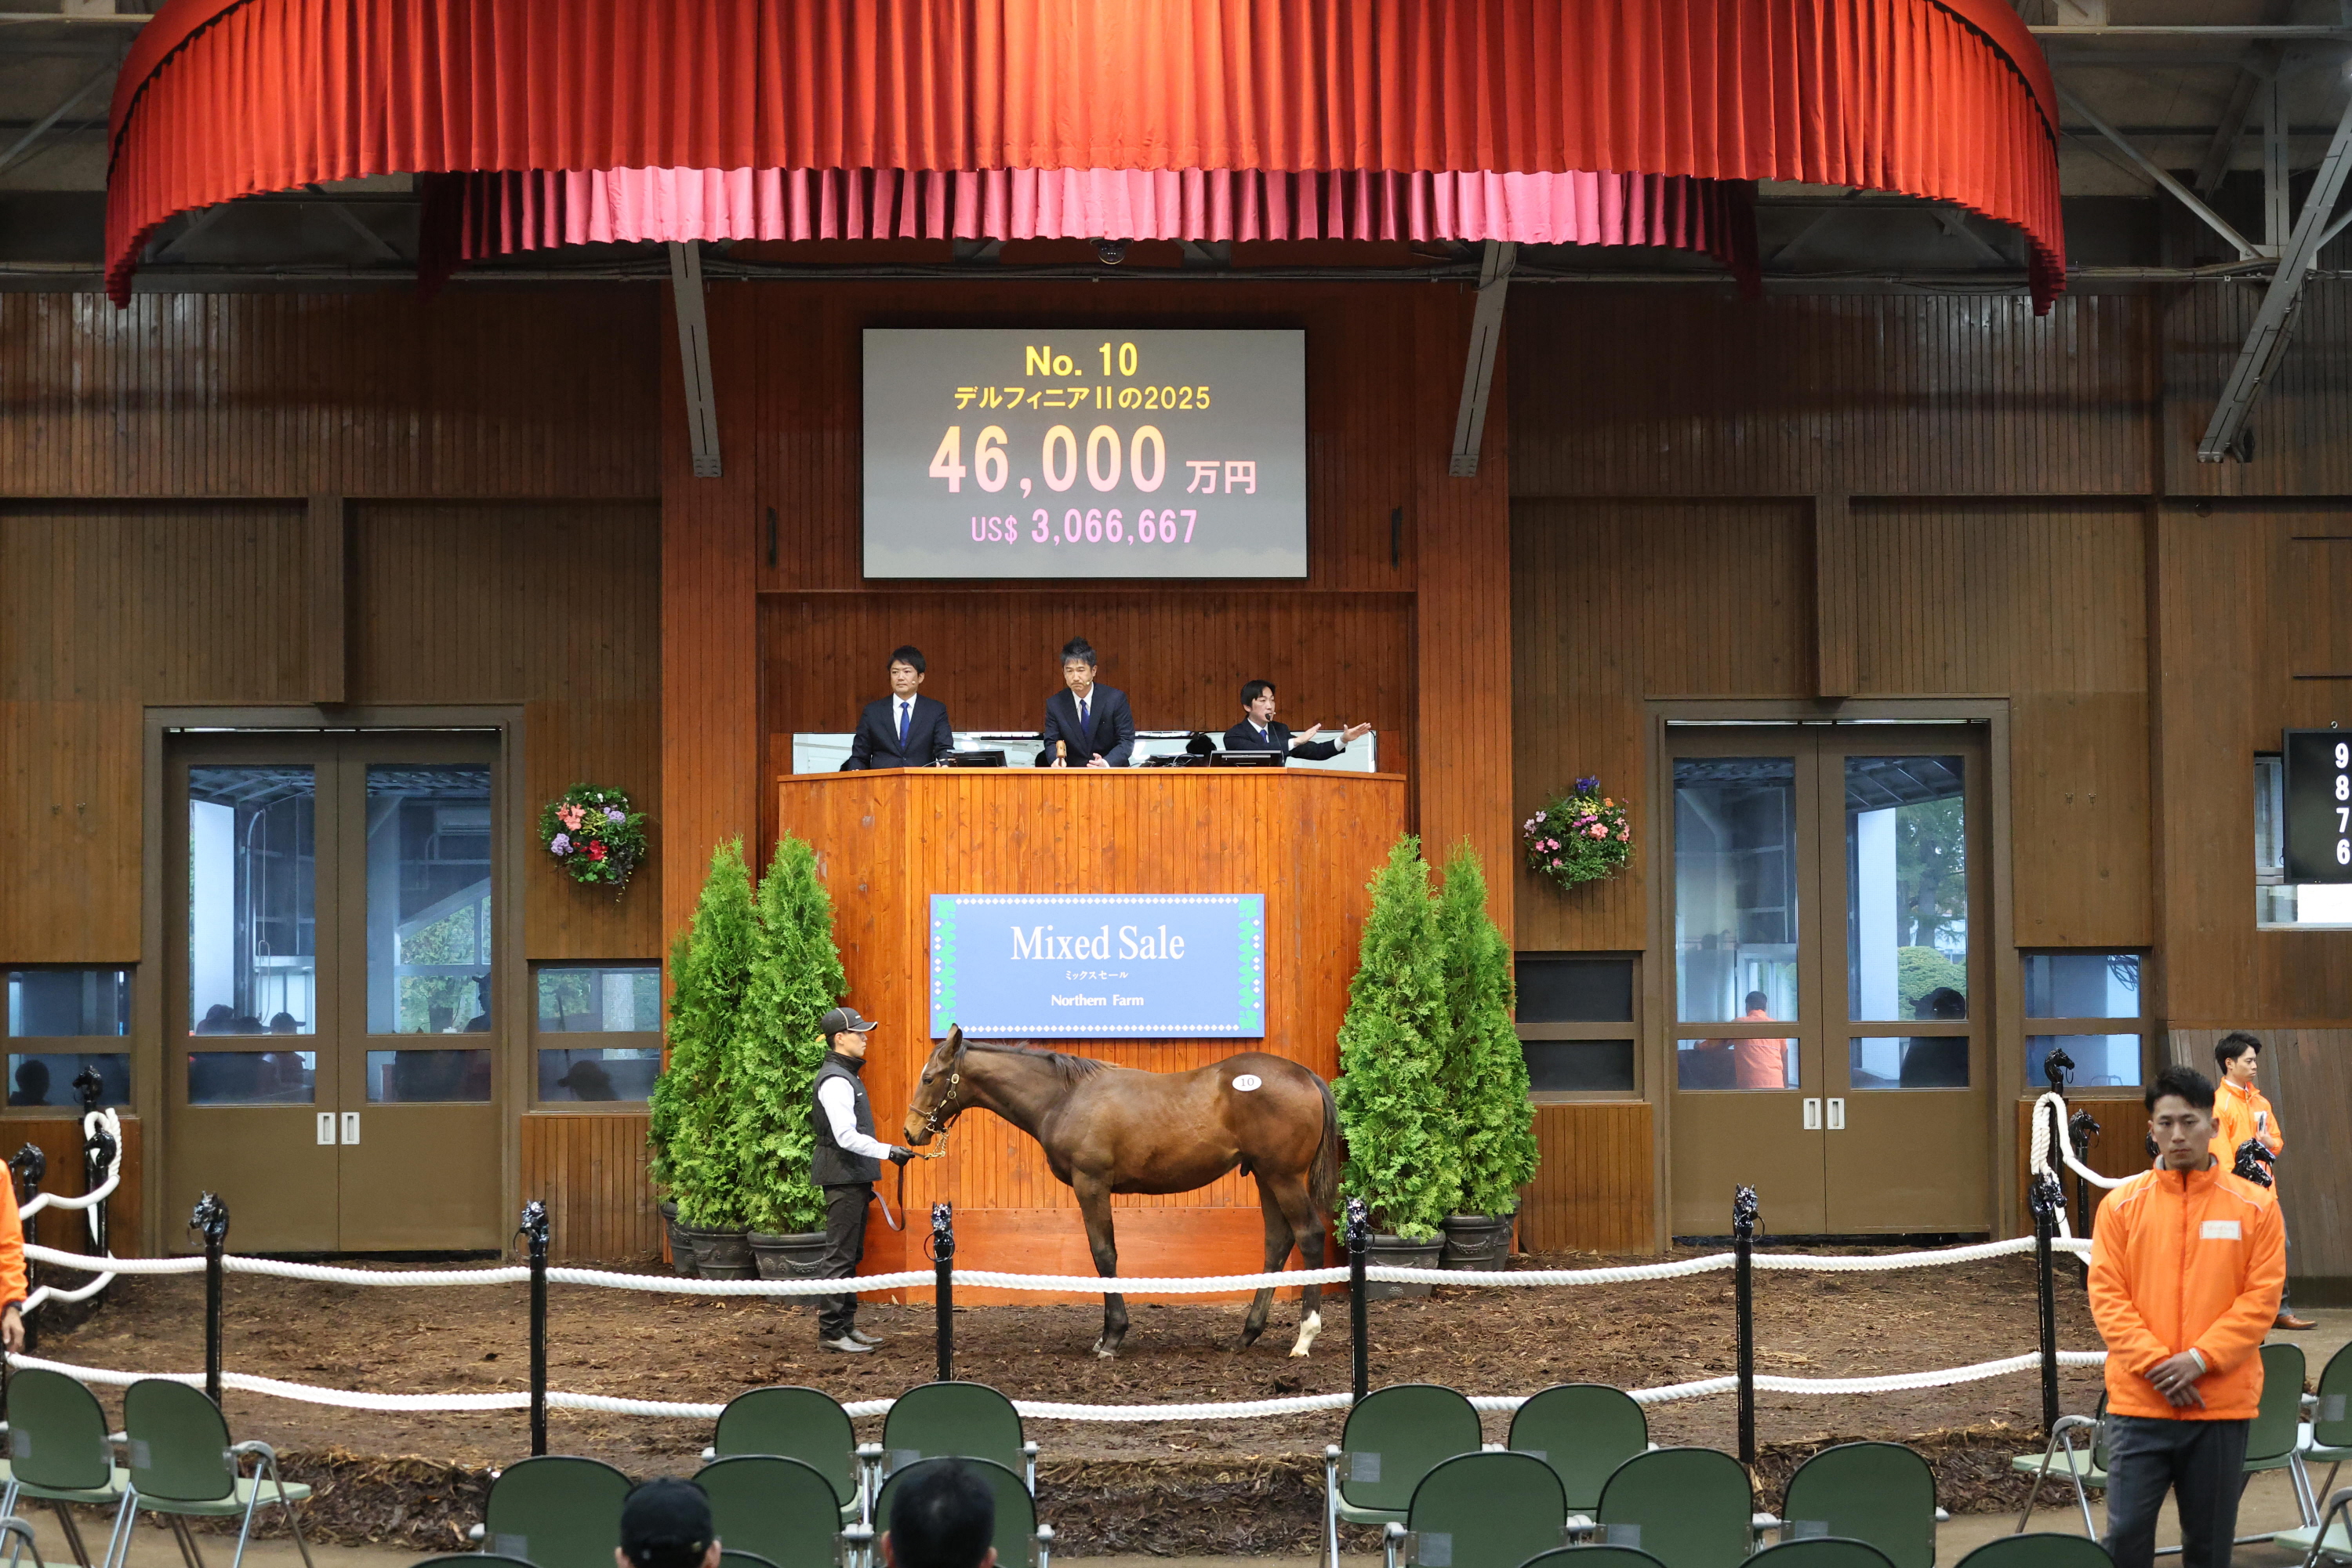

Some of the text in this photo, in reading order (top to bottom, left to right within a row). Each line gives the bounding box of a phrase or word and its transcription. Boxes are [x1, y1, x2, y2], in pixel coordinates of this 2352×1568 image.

[1025, 342, 1138, 376] No. 10
[929, 424, 1257, 498] 46,000 万円
[971, 508, 1198, 545] US$ 3,066,667
[2335, 742, 2349, 769] 9
[2335, 775, 2350, 800] 8
[2336, 807, 2350, 833] 7
[2336, 838, 2350, 865] 6
[1011, 924, 1185, 960] Mixed Sale
[1065, 970, 1129, 981] ミックスセール
[1051, 993, 1145, 1006] Northern Farm
[1240, 1077, 1254, 1087] 10
